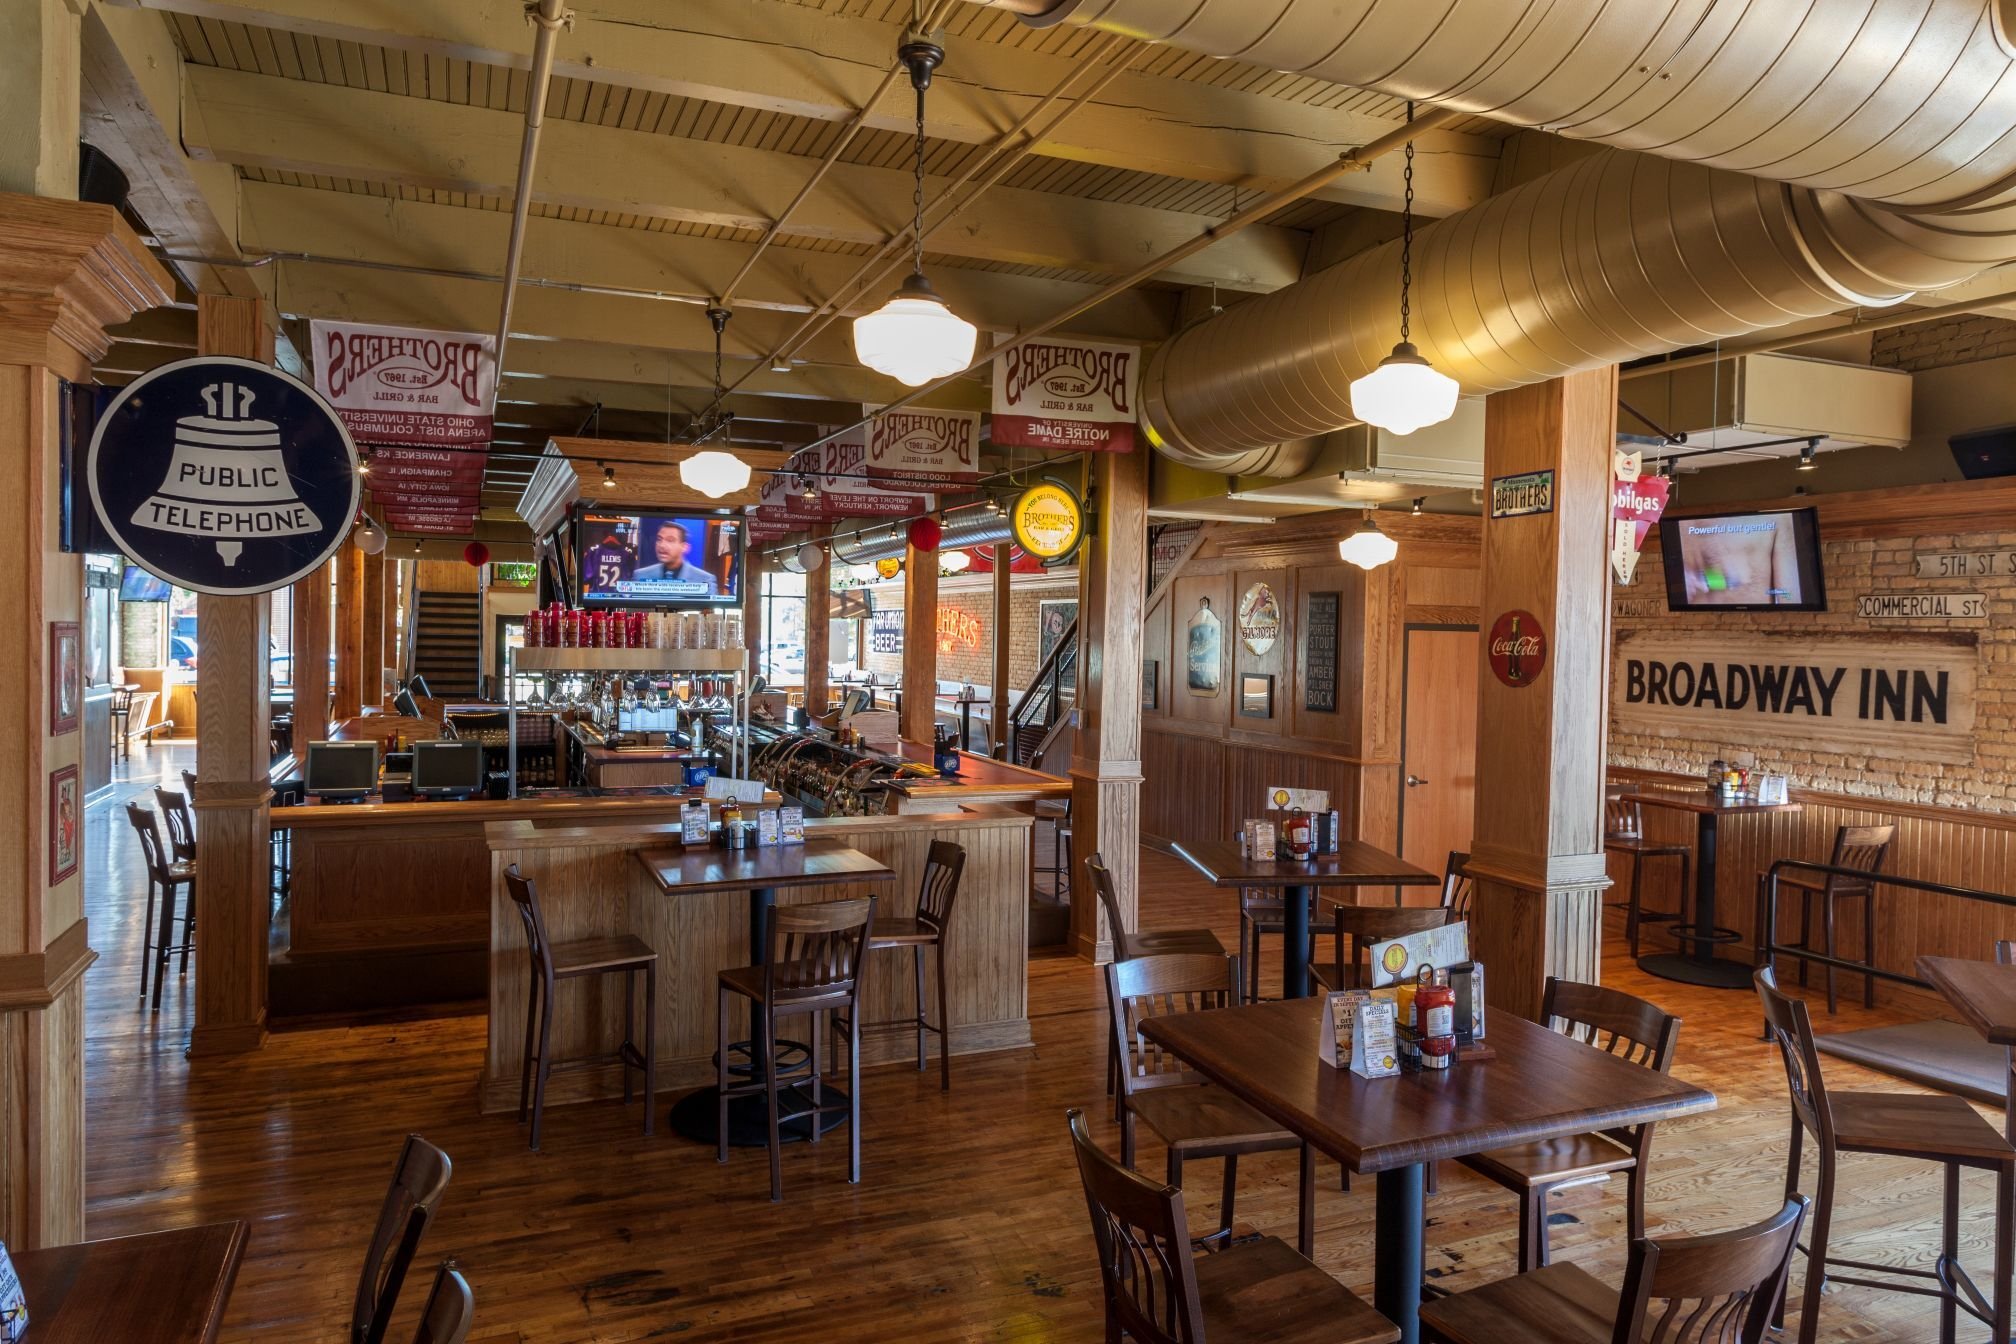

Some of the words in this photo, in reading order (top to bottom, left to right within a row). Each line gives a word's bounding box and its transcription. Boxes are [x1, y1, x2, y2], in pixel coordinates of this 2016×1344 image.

[179, 462, 279, 488] PUBLIC
[1495, 483, 1548, 511] BROTHERS
[1614, 489, 1659, 515] bilgas
[150, 502, 310, 533] TELEPHONE
[1023, 512, 1075, 532] BROTHERS
[1688, 525, 1726, 535] Powerful
[1727, 524, 1742, 533] but
[1743, 521, 1777, 534] gentle!
[1939, 555, 1967, 576] 5TH
[599, 565, 620, 588] 52
[1617, 600, 1662, 617] WAGONER
[1864, 595, 1952, 616] COMMERCIAL
[1962, 600, 1980, 616] ST
[1242, 626, 1276, 640] GILMORE
[1309, 624, 1336, 636] PORTER
[875, 633, 896, 652] BEER
[1309, 635, 1335, 649] STOUT
[1308, 666, 1335, 679] AMBER
[1308, 679, 1334, 690] PILSNER
[1626, 659, 1848, 718] BROADWAY
[1858, 667, 1950, 724] INN
[1308, 690, 1333, 706] BOCK
